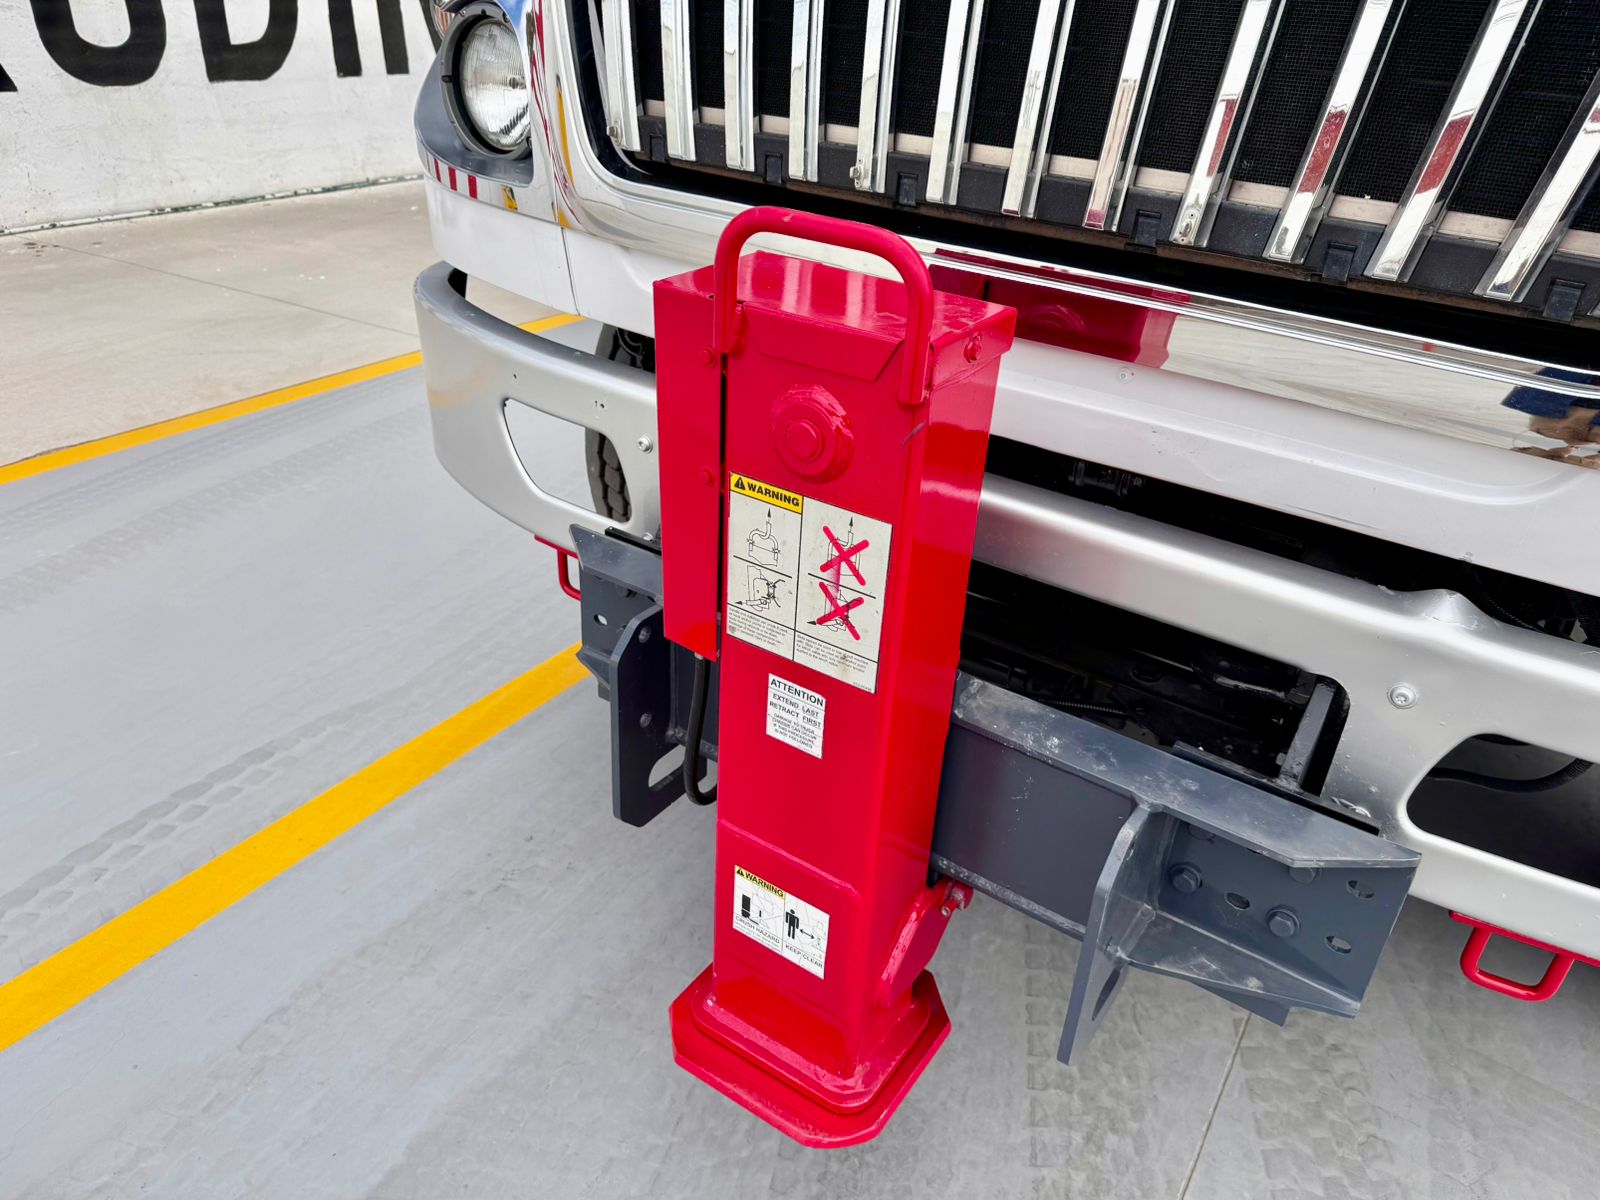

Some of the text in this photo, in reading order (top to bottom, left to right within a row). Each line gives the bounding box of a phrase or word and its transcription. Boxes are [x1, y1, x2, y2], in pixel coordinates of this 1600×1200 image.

[747, 482, 800, 507] WARNING
[771, 679, 824, 707] ATTENTION
[773, 694, 819, 717] EXTEND LAST
[770, 701, 821, 728] RETRACT FIRST
[745, 873, 784, 897] WARNING
[735, 915, 755, 932] CRUSH
[755, 927, 780, 944] HAZARD
[785, 944, 823, 968] KEEP CLEAR
